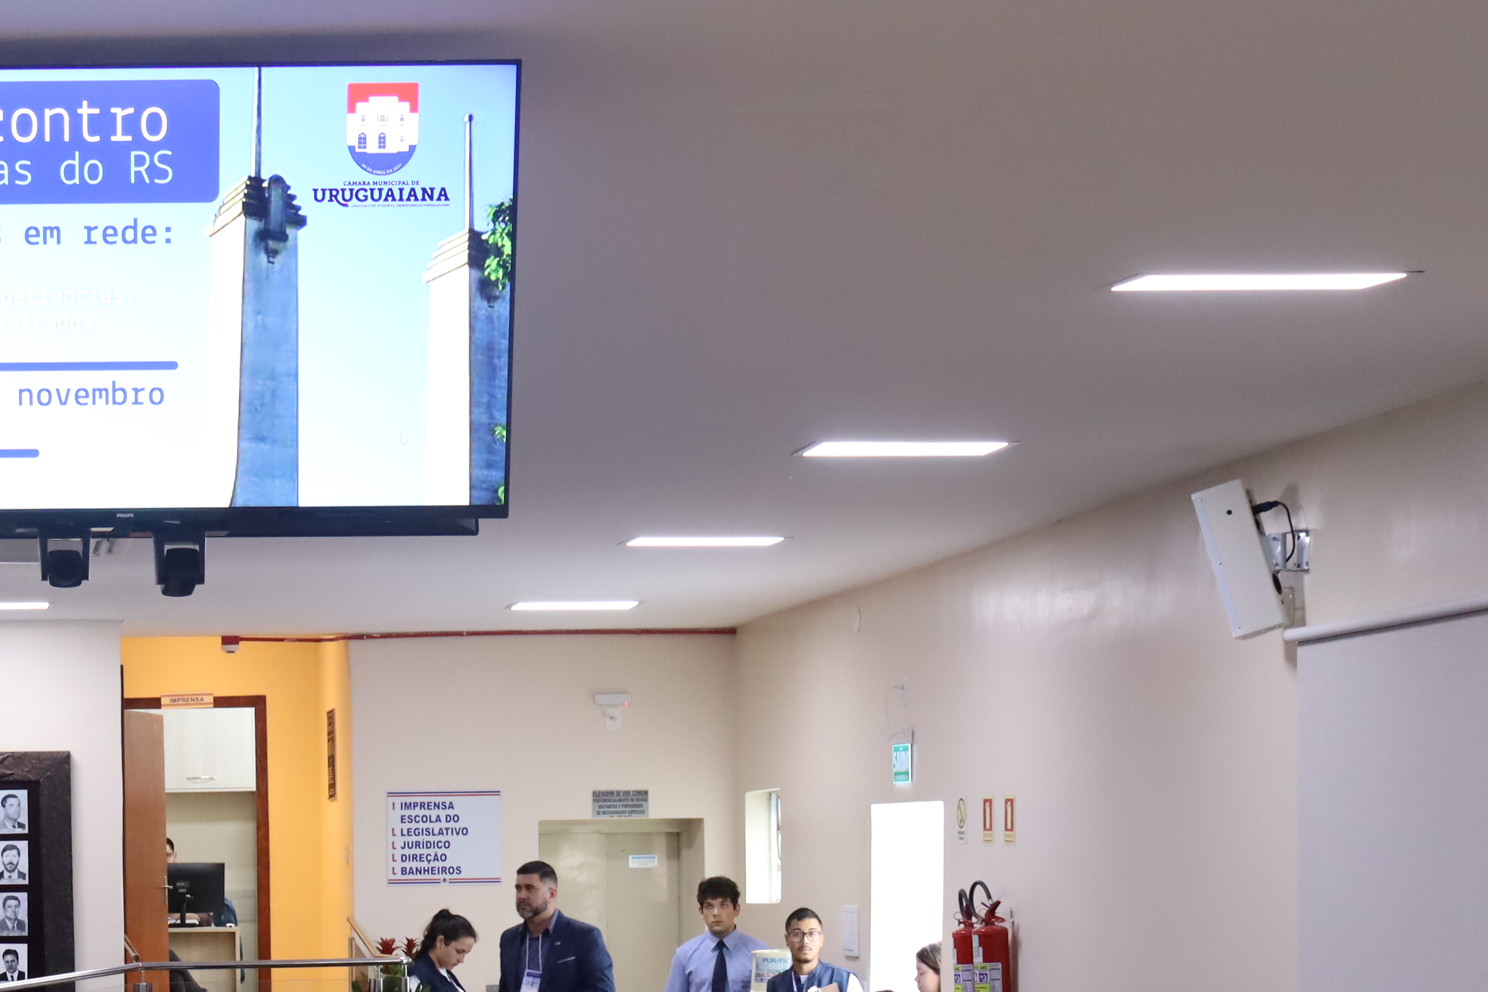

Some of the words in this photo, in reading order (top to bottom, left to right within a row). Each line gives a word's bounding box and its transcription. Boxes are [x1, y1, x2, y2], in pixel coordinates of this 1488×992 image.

[60, 151, 104, 185] do
[129, 150, 174, 186] RS
[343, 179, 371, 187] CÂMARA
[312, 187, 450, 206] URUGUAIANA
[24, 224, 62, 246] em
[83, 218, 174, 245] rede:
[18, 381, 166, 407] novembro
[169, 696, 205, 704] IMPRENSA
[400, 801, 454, 810] IMPRENSA
[400, 814, 441, 823] ESCOLA
[445, 814, 460, 823] DO
[400, 827, 469, 837] LEGISLATIVO
[400, 839, 451, 849] JURÍDICO
[400, 851, 447, 864] DIREÇÃO
[401, 866, 462, 875] BANHEIROS
